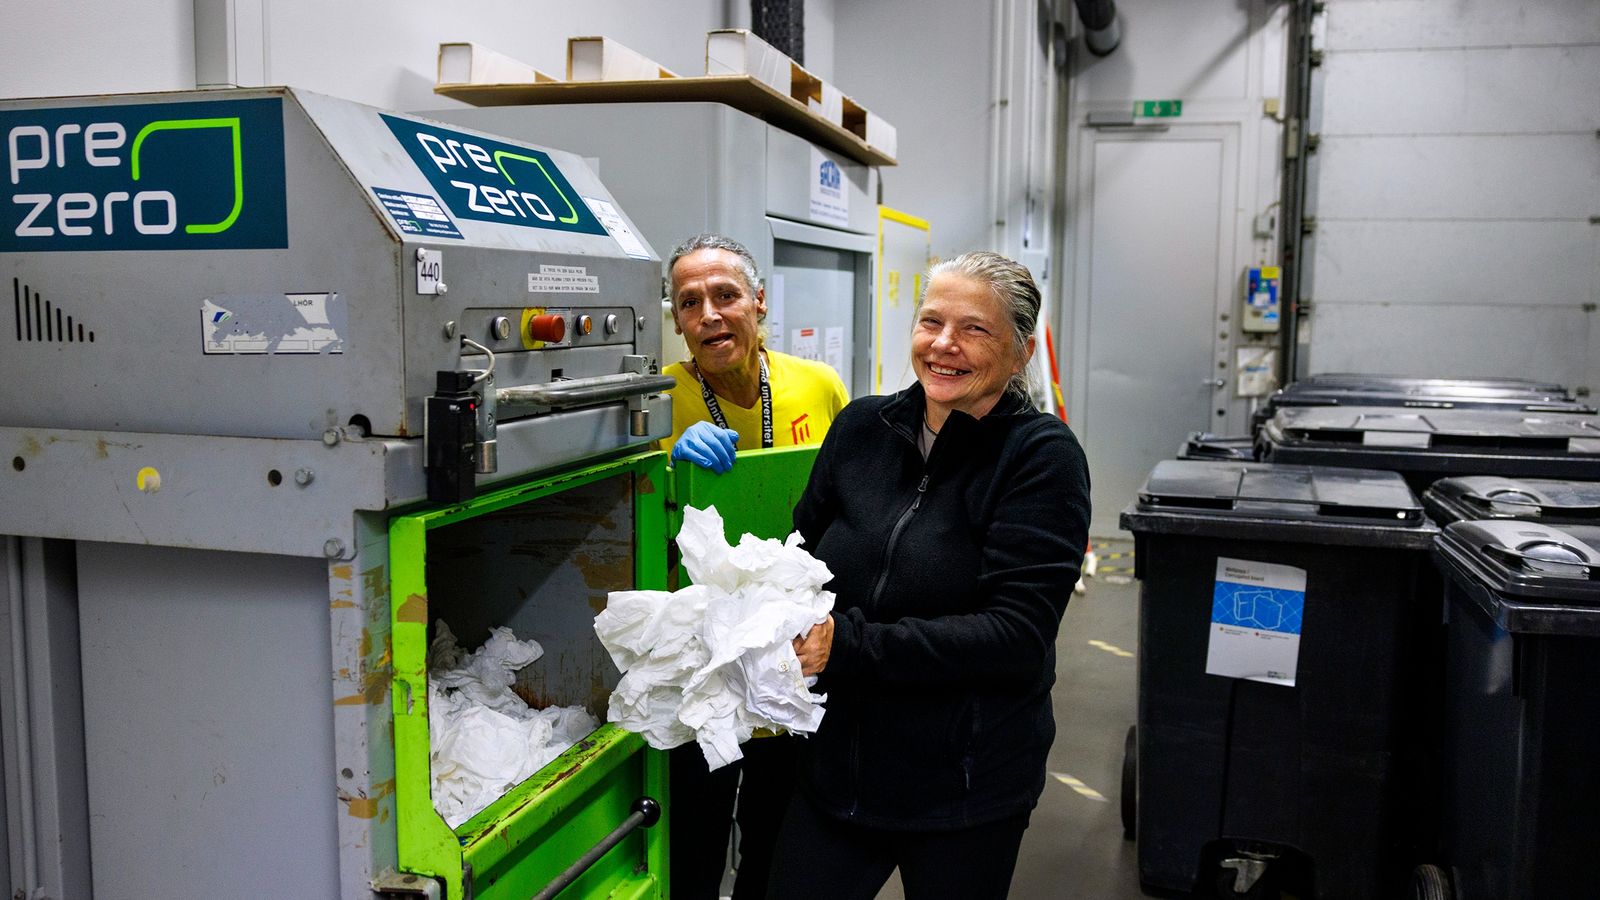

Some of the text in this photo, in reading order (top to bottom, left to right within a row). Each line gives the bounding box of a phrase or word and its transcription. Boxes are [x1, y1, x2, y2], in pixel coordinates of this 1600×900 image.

[8, 121, 126, 184] pre
[416, 132, 499, 173] pre
[12, 190, 177, 236] zero
[450, 180, 556, 222] zero
[421, 261, 440, 281] 440
[706, 398, 727, 430] Unive
